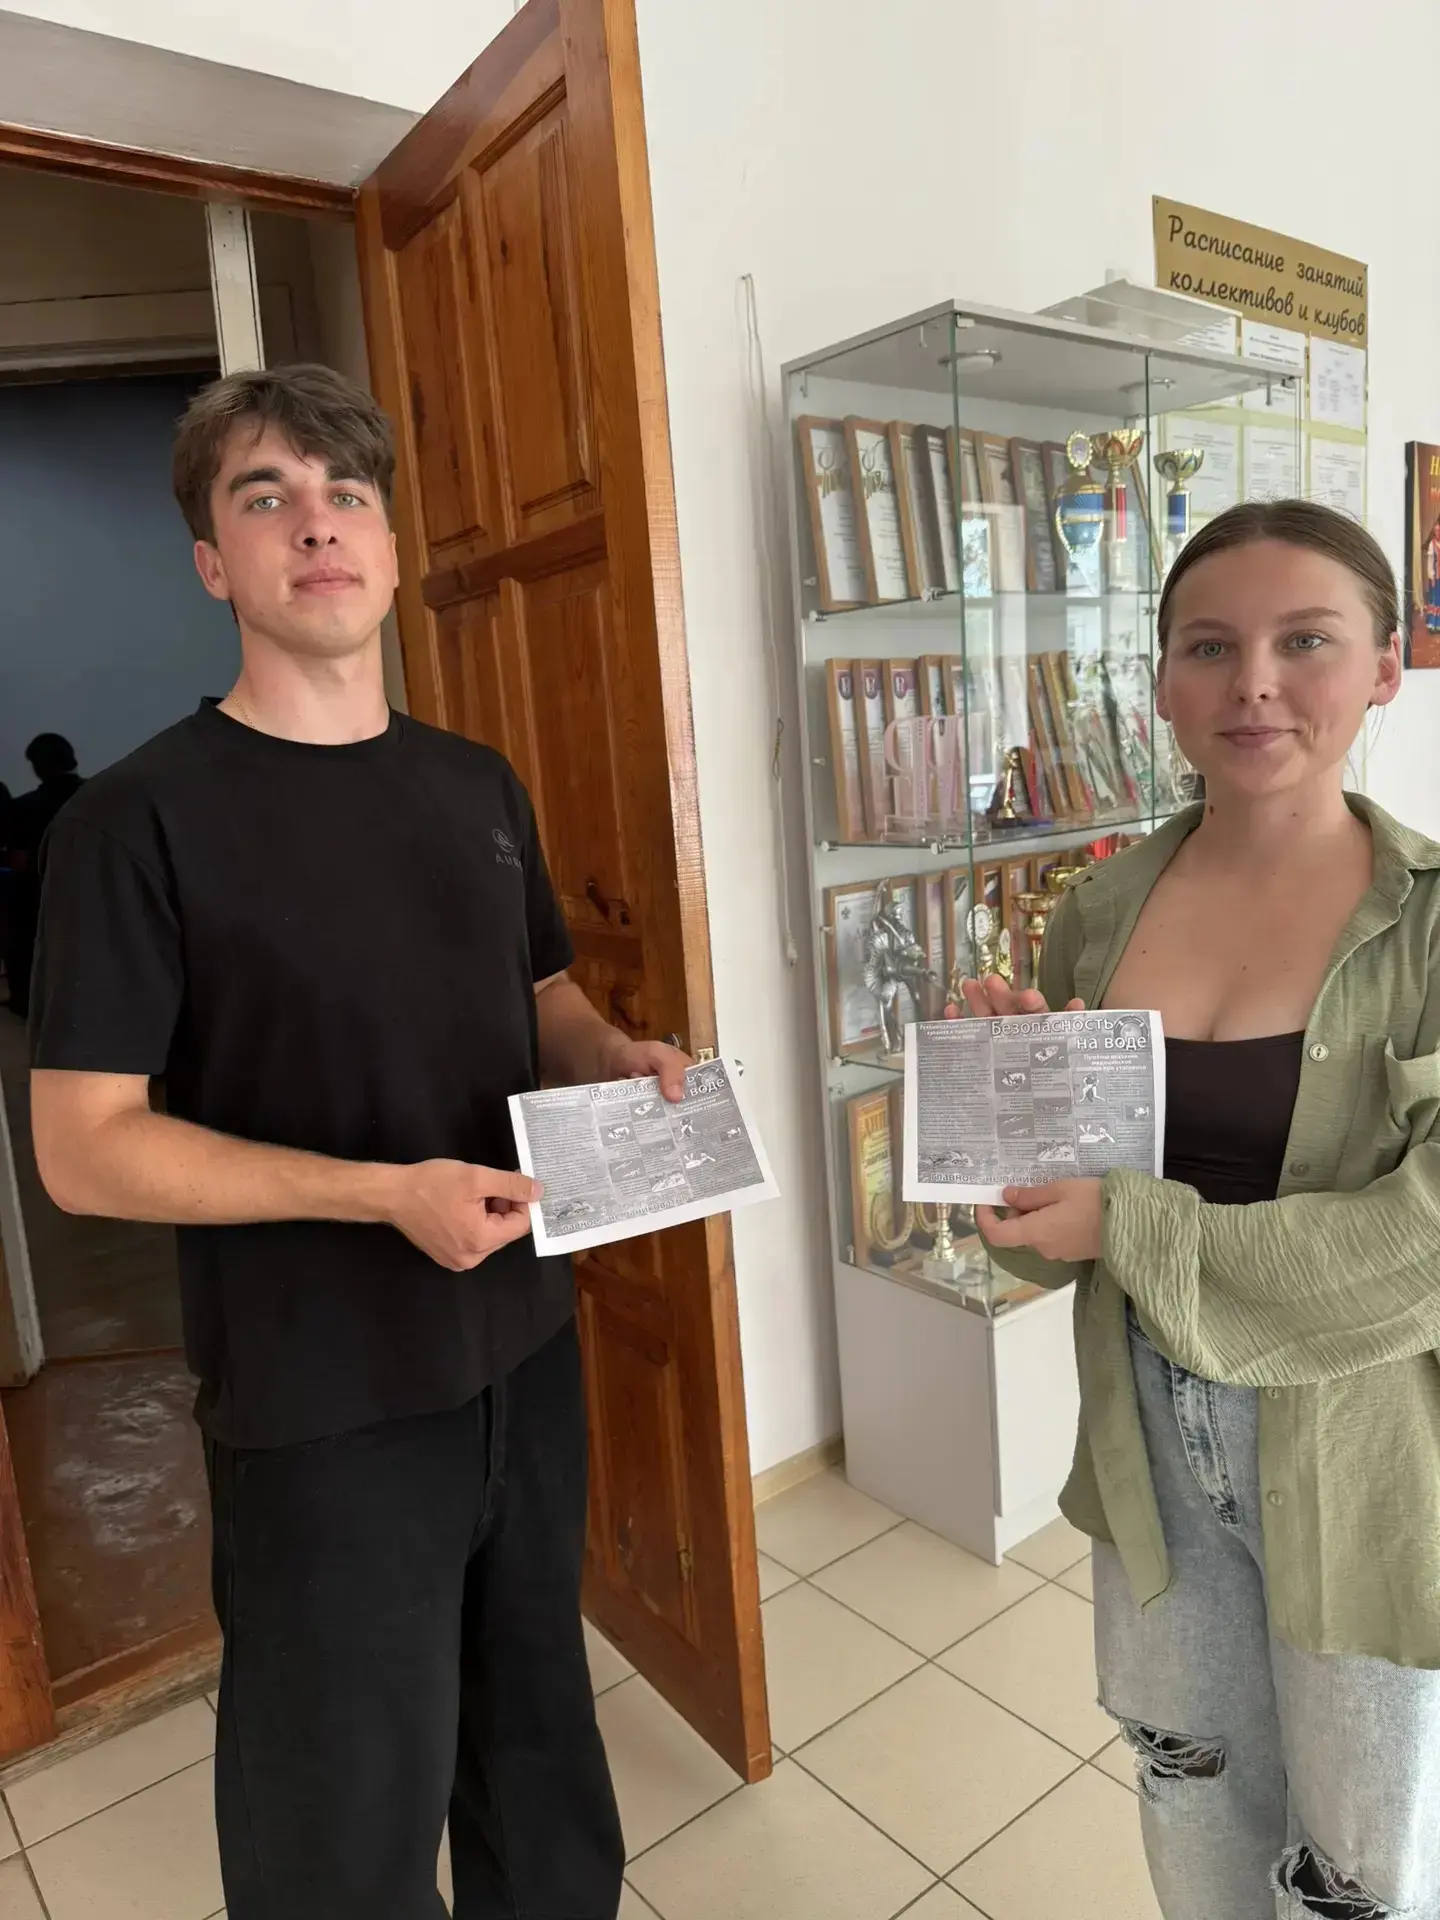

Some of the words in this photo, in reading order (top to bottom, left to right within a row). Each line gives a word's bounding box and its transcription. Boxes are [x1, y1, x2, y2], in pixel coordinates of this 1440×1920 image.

[1168, 214, 1285, 273] Расписание
[1296, 261, 1365, 298] занятий
[1169, 268, 1294, 316] коллективов
[1298, 305, 1309, 321] и
[1314, 305, 1366, 336] клубов
[991, 1017, 1114, 1037] Безопасность
[1076, 1037, 1098, 1050] на
[1104, 1035, 1147, 1050] воде
[690, 1078, 725, 1097] воде
